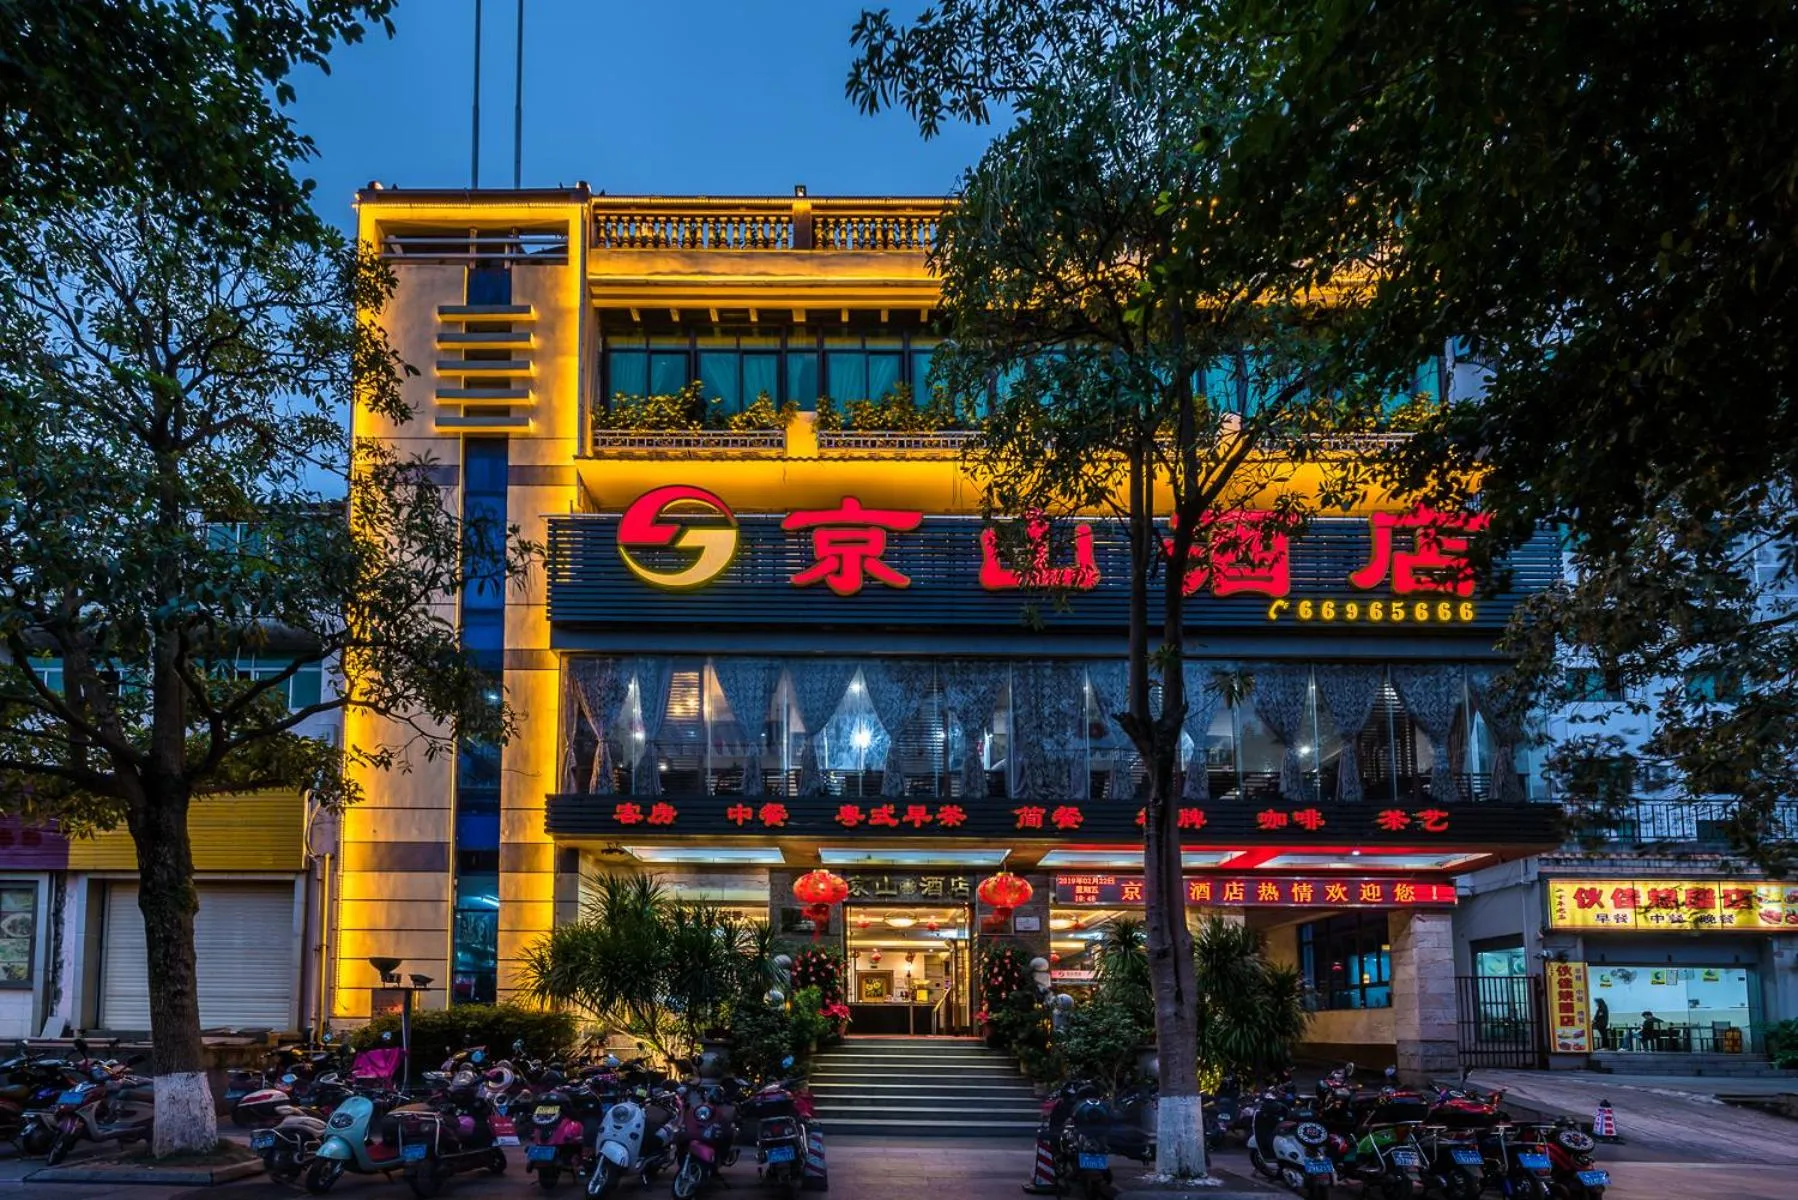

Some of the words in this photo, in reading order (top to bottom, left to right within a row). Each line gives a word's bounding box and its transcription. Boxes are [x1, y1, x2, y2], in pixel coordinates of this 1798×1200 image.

[1299, 601, 1475, 621] 66965666
[613, 803, 678, 825] 客房
[728, 803, 789, 826] 中餐
[836, 804, 967, 827] 粤式早茶
[1014, 806, 1084, 830] 简餐
[1135, 807, 1206, 830] 牌
[1255, 808, 1325, 831] 咖啡
[1376, 808, 1449, 832] 茶艺
[1121, 881, 1439, 902] 京酒店热情欢迎您！
